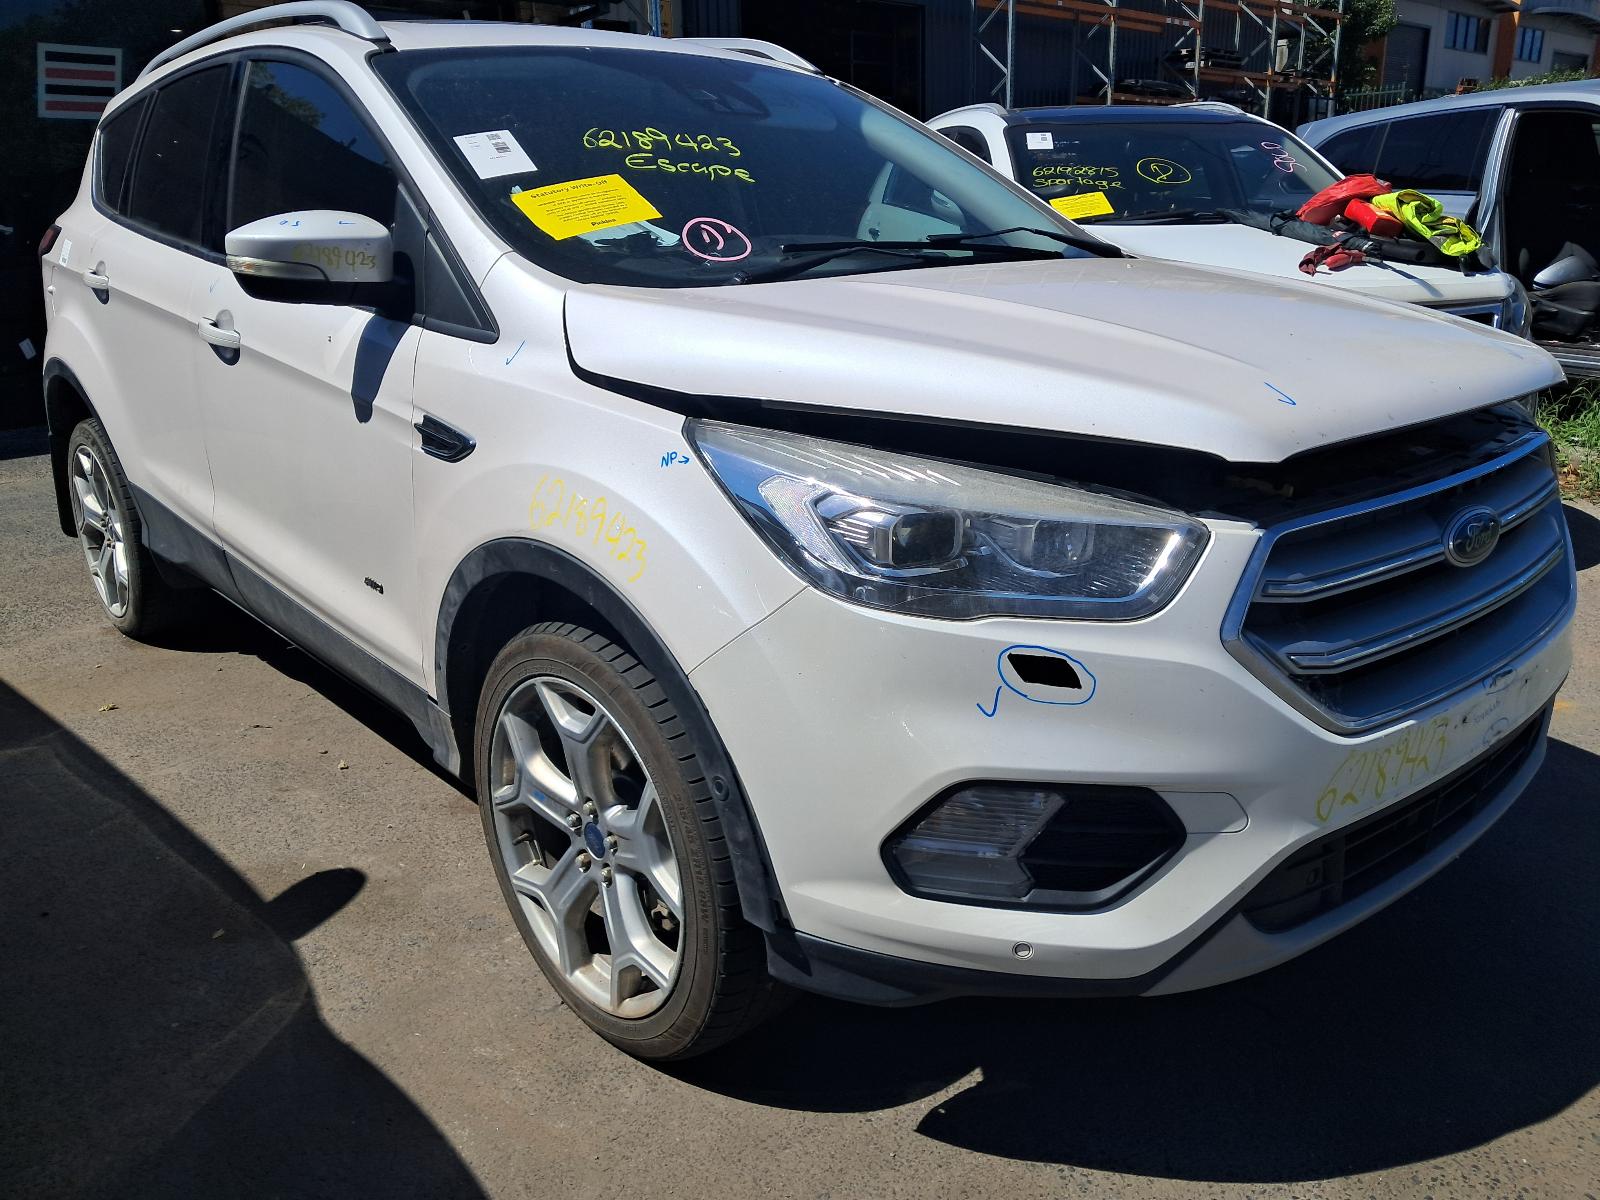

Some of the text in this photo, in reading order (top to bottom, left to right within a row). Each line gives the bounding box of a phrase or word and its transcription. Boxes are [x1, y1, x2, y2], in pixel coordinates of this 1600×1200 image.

[582, 127, 741, 156] 62189423
[625, 153, 756, 182] Escape
[660, 451, 678, 468] NP
